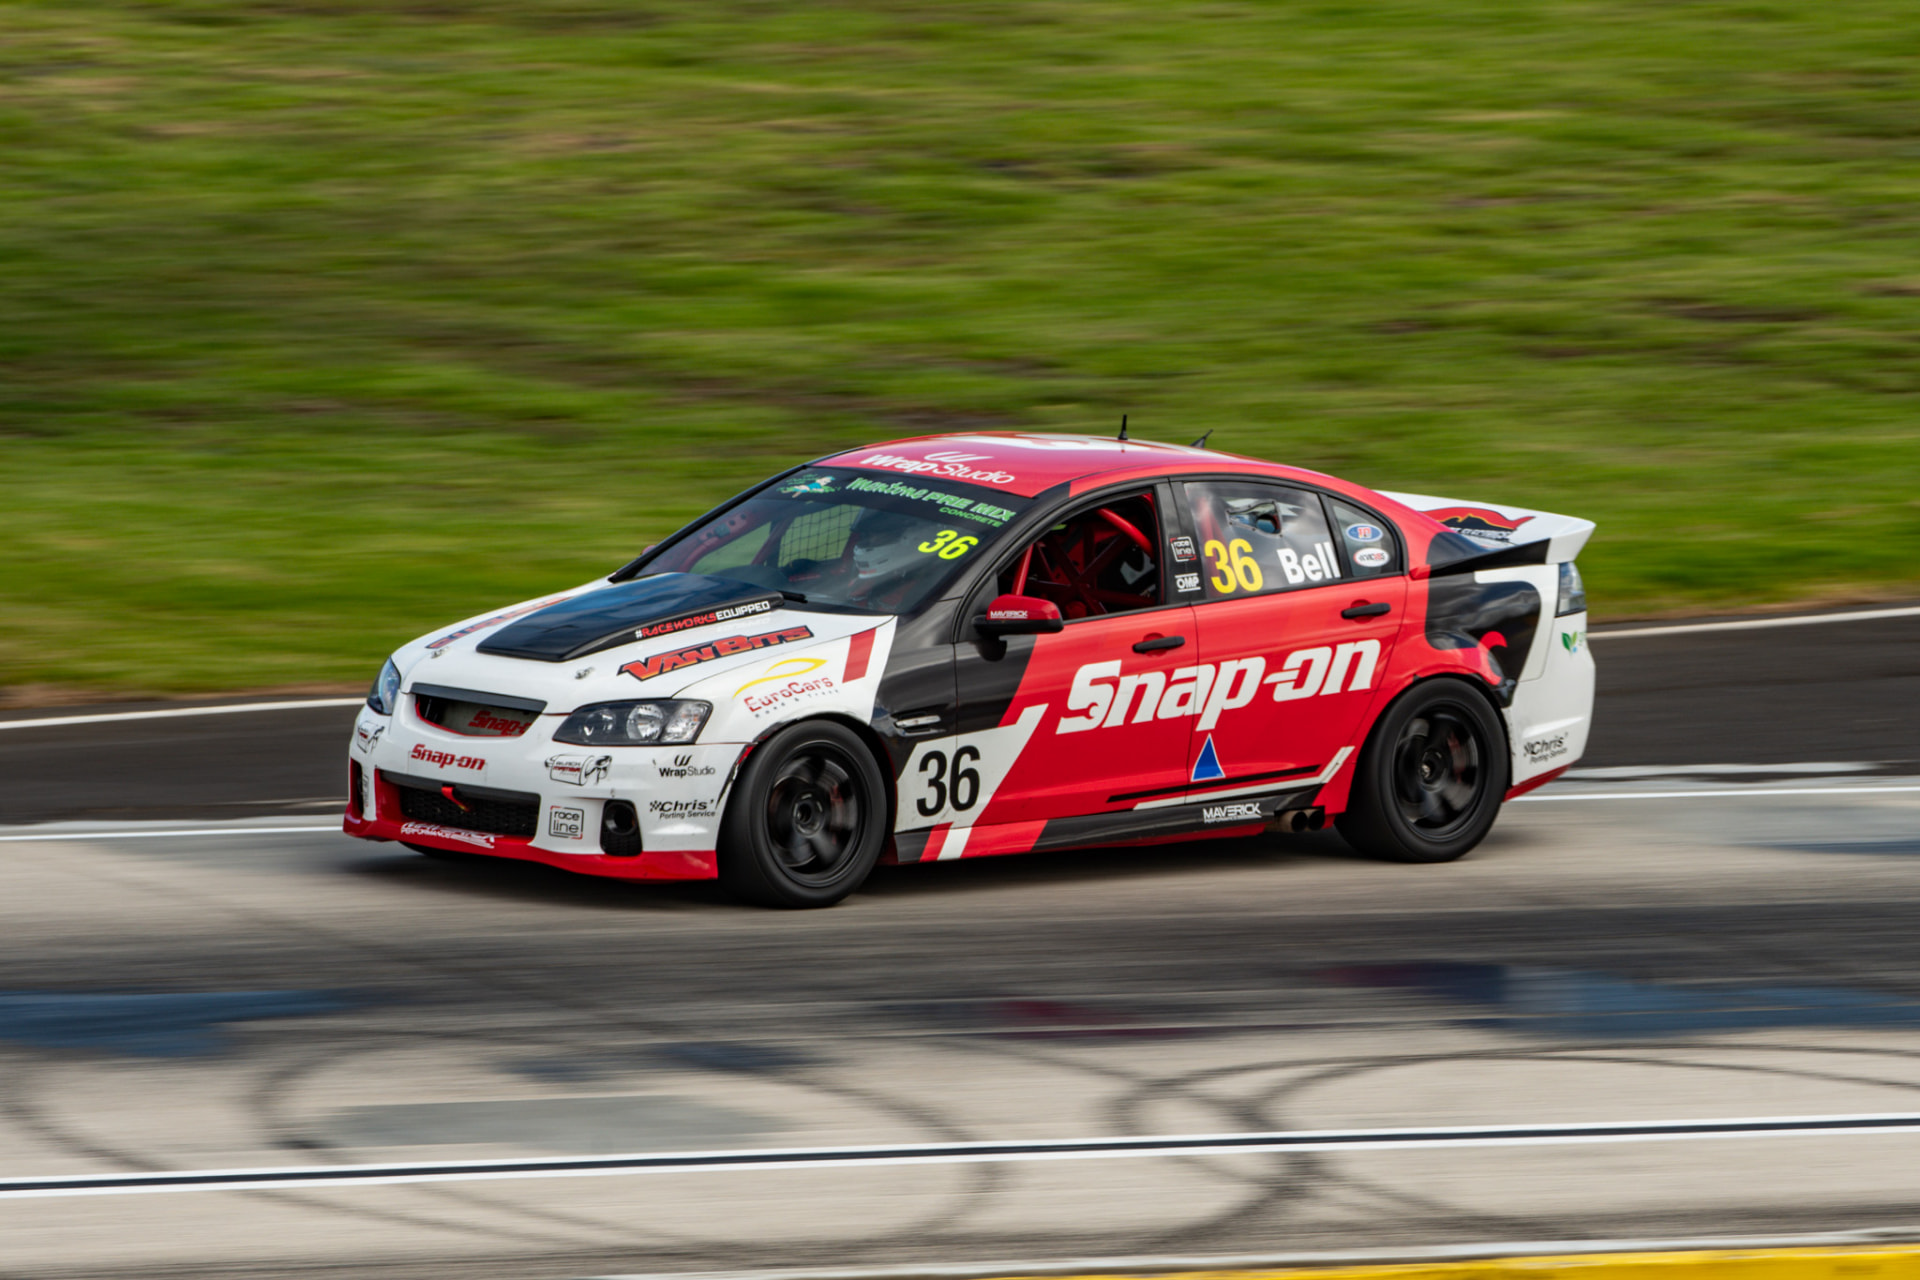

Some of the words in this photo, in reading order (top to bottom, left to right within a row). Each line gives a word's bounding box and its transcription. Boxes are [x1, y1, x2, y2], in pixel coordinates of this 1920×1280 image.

[922, 491, 974, 510] PRE
[970, 502, 1016, 522] MIX
[938, 506, 1004, 528] CONCRETE
[917, 529, 979, 560] 36
[1204, 538, 1264, 594] 36
[1276, 542, 1342, 585] Bell
[1176, 575, 1200, 589] OMP
[990, 610, 1028, 618] MAVERICK
[743, 677, 834, 713] EuroCars
[1055, 639, 1381, 735] Snap-on
[411, 743, 486, 771] Snap-on
[916, 745, 981, 818] 36
[554, 811, 580, 821] race
[660, 811, 685, 820] Porting
[687, 810, 716, 818] Service
[1203, 802, 1262, 819] MAVERICK
[553, 819, 579, 834] line
